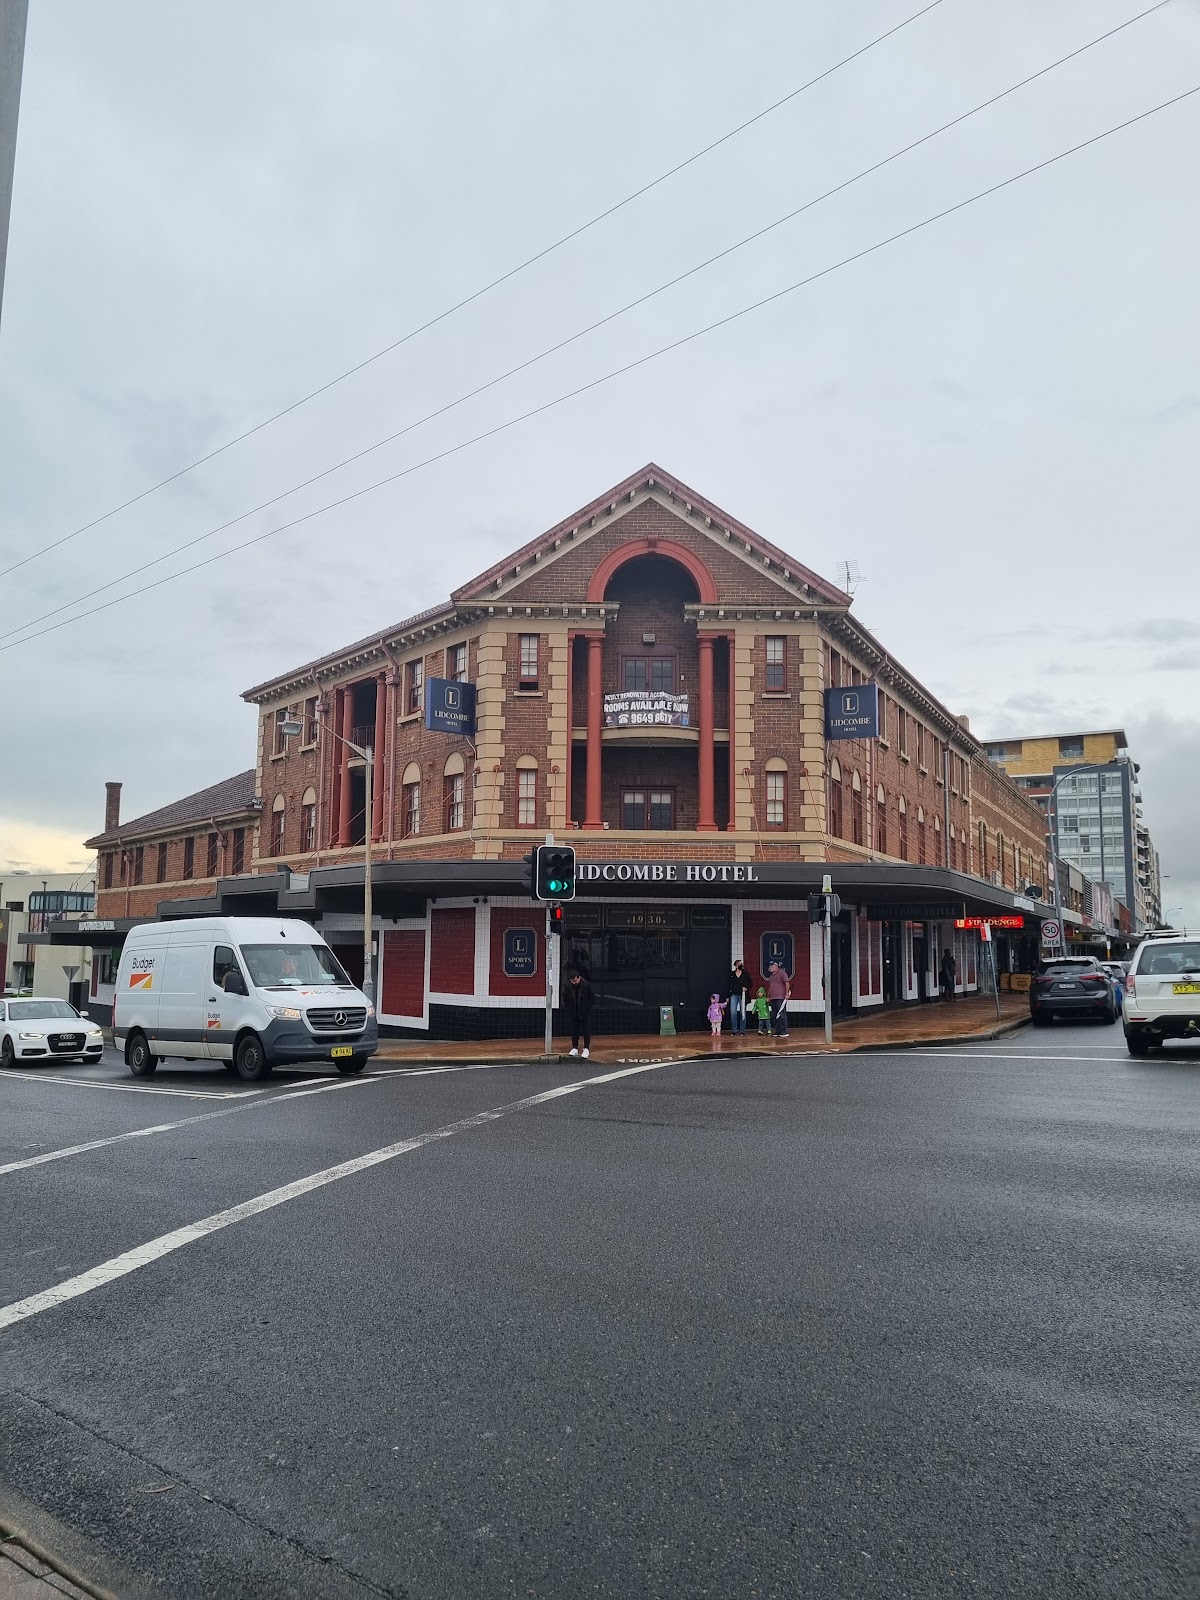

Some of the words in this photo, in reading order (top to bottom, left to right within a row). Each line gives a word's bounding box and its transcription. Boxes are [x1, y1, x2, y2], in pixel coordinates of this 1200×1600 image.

[448, 691, 457, 705] L
[604, 693, 620, 701] NEWLY
[620, 691, 649, 699] RENOVATED
[603, 701, 629, 713] ROOMS
[630, 700, 672, 711] AVAILABLE
[672, 702, 689, 713] NOW
[845, 697, 856, 711] L
[434, 710, 470, 722] LIDCOMBE
[630, 713, 653, 724] 9649
[654, 712, 673, 724] 8677
[830, 717, 871, 727] LIDCOMBE
[574, 864, 678, 881] IDCOMBE
[686, 865, 759, 882] HOTEL
[632, 915, 662, 924] 1930
[982, 918, 1020, 927] LOUNGE
[1045, 926, 1056, 934] 50
[515, 939, 525, 951] L
[773, 942, 782, 955] L
[132, 957, 155, 972] Budget
[207, 1012, 221, 1020] Budget
